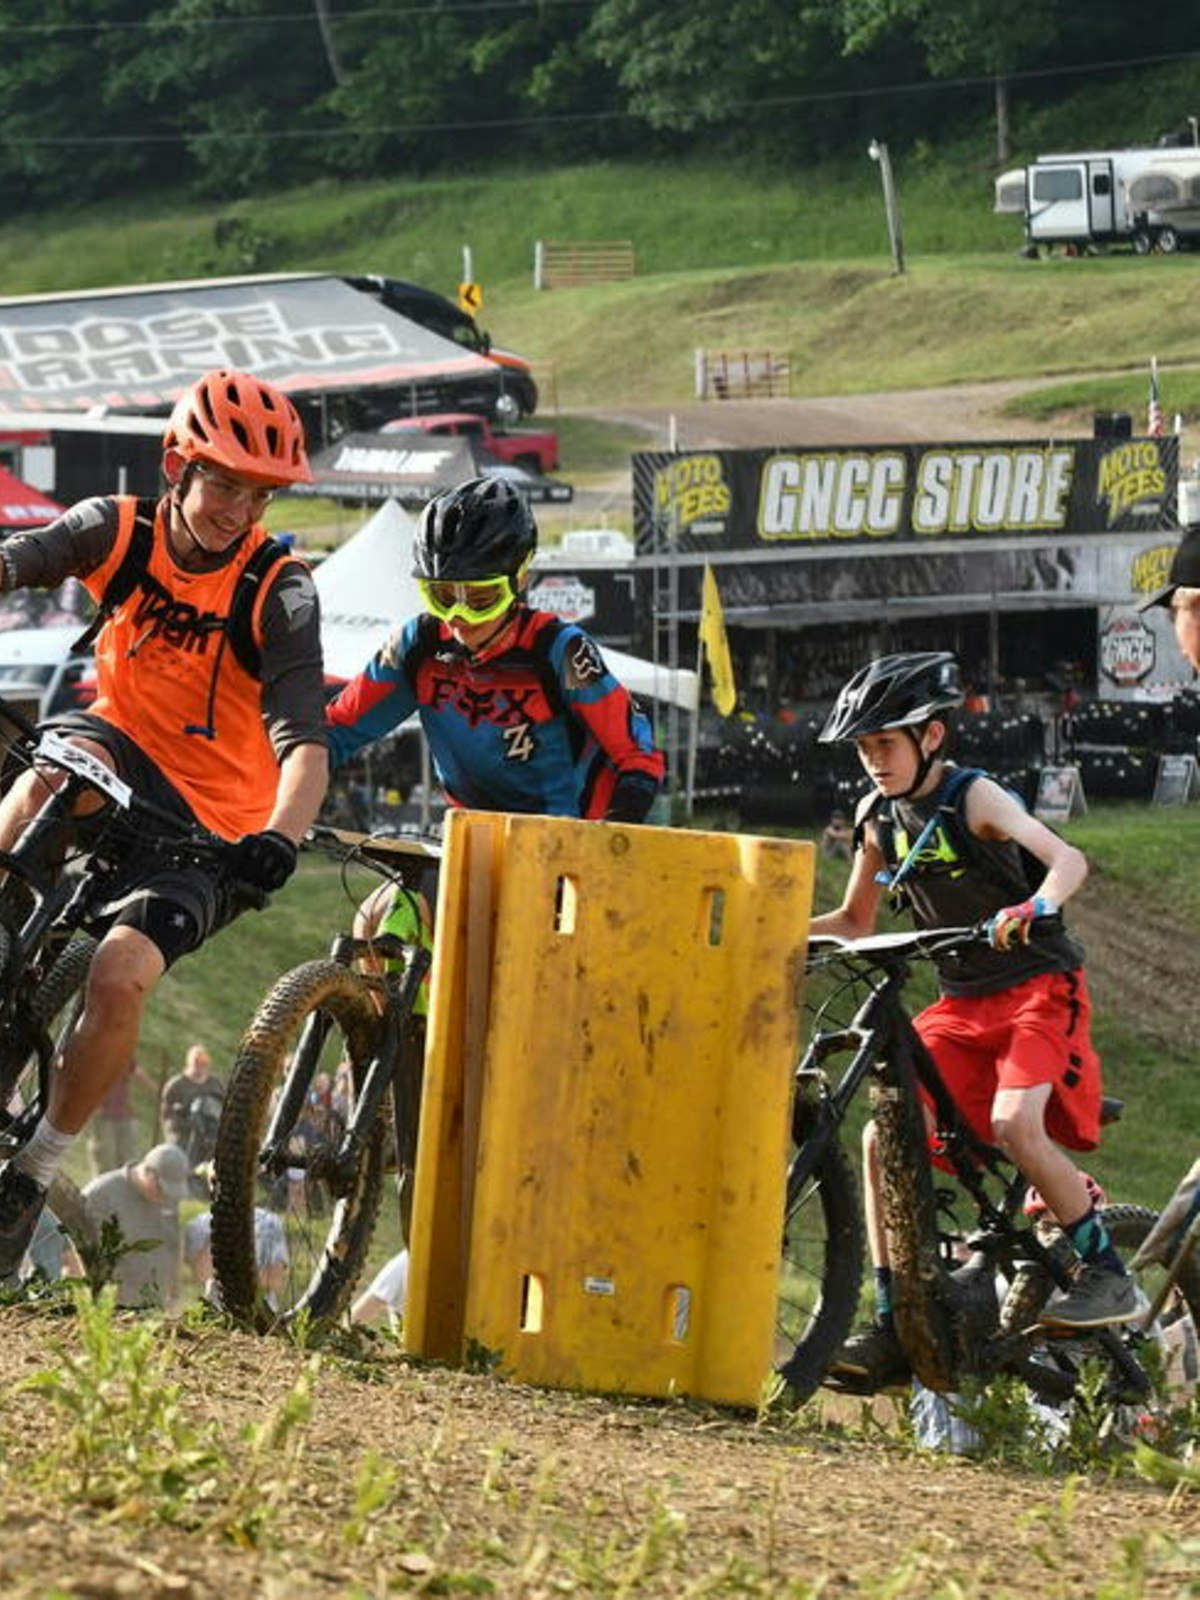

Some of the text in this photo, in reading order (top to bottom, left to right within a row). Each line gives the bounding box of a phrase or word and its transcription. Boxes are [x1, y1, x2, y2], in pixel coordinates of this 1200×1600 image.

[12, 325, 399, 391] RACING
[760, 448, 1075, 538] GNCC STORE
[1099, 442, 1158, 498] MOTO
[1108, 468, 1165, 527] TEES
